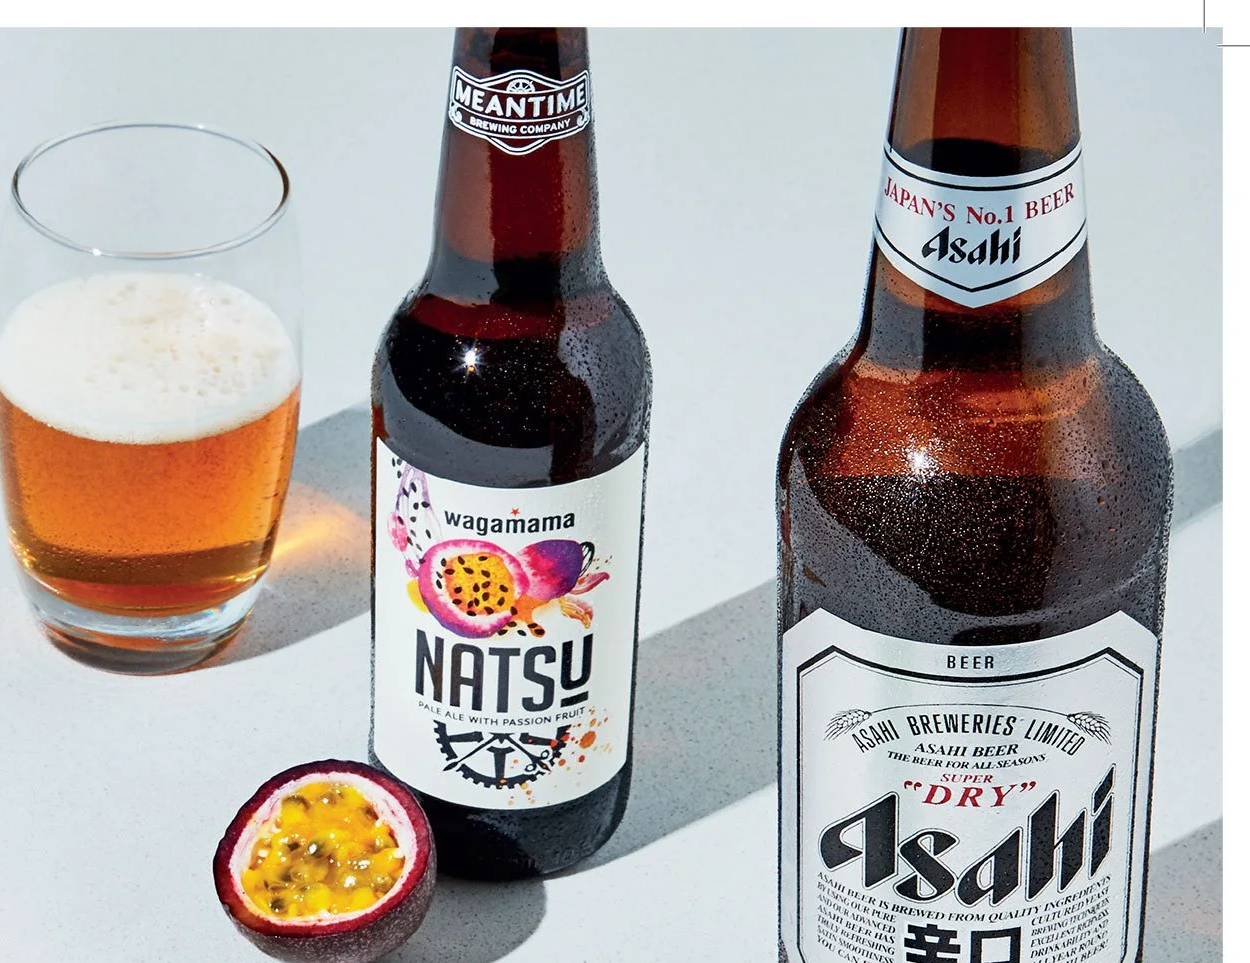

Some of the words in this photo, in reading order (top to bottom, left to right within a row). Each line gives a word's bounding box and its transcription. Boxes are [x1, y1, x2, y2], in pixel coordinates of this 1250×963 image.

[455, 79, 585, 118] MEANTIME
[469, 116, 517, 134] BREWING
[519, 118, 571, 134] COMPANY
[884, 176, 956, 222] JAPAN’S
[966, 205, 1014, 225] No.1
[1025, 182, 1075, 220] BEER
[921, 225, 1022, 265] Asahi
[444, 509, 576, 536] wagamama
[414, 628, 594, 713] NATSU
[947, 655, 994, 669] BEER
[418, 700, 442, 716] PALE
[445, 711, 465, 722] ALE
[468, 715, 499, 726] WITH
[502, 716, 552, 726] PASSION
[555, 706, 586, 722] FRUIT
[852, 720, 899, 753] ASAHI
[907, 714, 1017, 736] BREWERIES
[1024, 719, 1086, 756] LIMITED
[914, 743, 967, 757] ASAHI
[972, 743, 1019, 757] BEER
[887, 751, 911, 763] THE
[912, 756, 943, 768] BEER
[945, 759, 969, 769] FOR
[940, 773, 994, 784] SUPER
[818, 762, 1117, 908] Asahi
[817, 881, 827, 891] BY
[829, 887, 850, 906] USING
[852, 898, 870, 914] OUR
[871, 908, 897, 923] PURE
[818, 871, 846, 893] ASAHI
[847, 885, 876, 905] BEER
[878, 900, 890, 910] IS
[891, 904, 945, 920] BREWED
[948, 911, 985, 922] FROM
[988, 905, 1042, 923] QUALITY
[1044, 874, 1112, 912] INGREDIENTS
[816, 934, 835, 952] YOU
[837, 948, 859, 963] CAN
